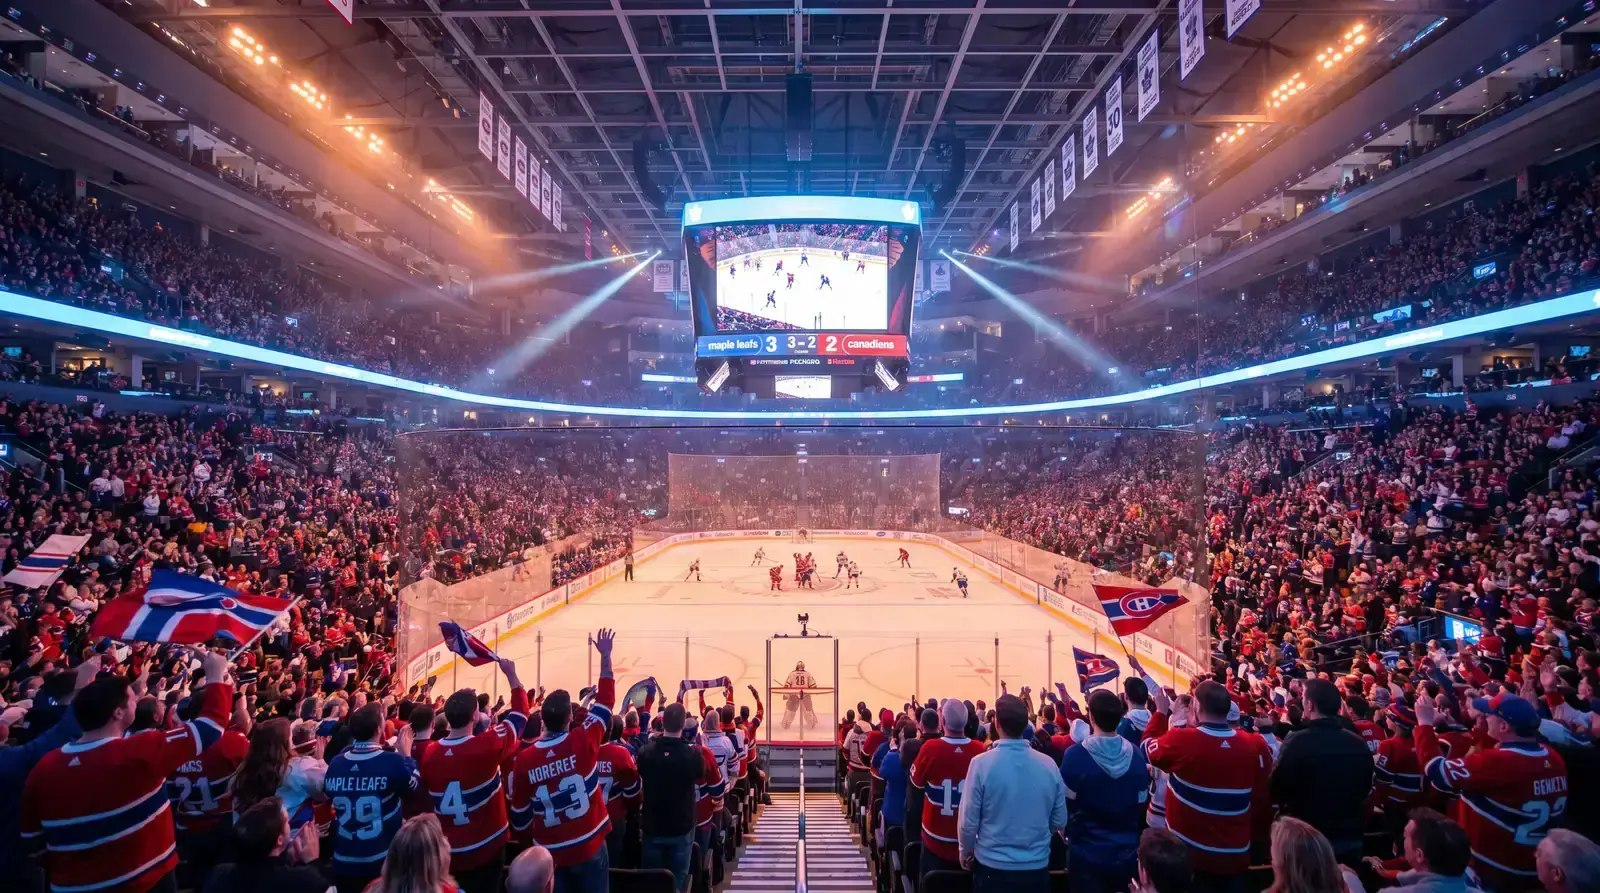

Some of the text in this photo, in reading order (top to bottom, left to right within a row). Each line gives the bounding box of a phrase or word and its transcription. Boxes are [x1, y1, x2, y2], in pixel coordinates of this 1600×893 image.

[1107, 107, 1121, 137] 30
[708, 340, 735, 352] maple
[736, 339, 758, 349] leafs
[765, 335, 777, 352] 3
[825, 335, 838, 352] 2
[847, 339, 895, 349] canadiens
[175, 776, 219, 811] 21
[356, 776, 388, 791] LEAFS
[535, 774, 590, 828] 13
[333, 796, 383, 840] 29
[440, 780, 470, 826] 4
